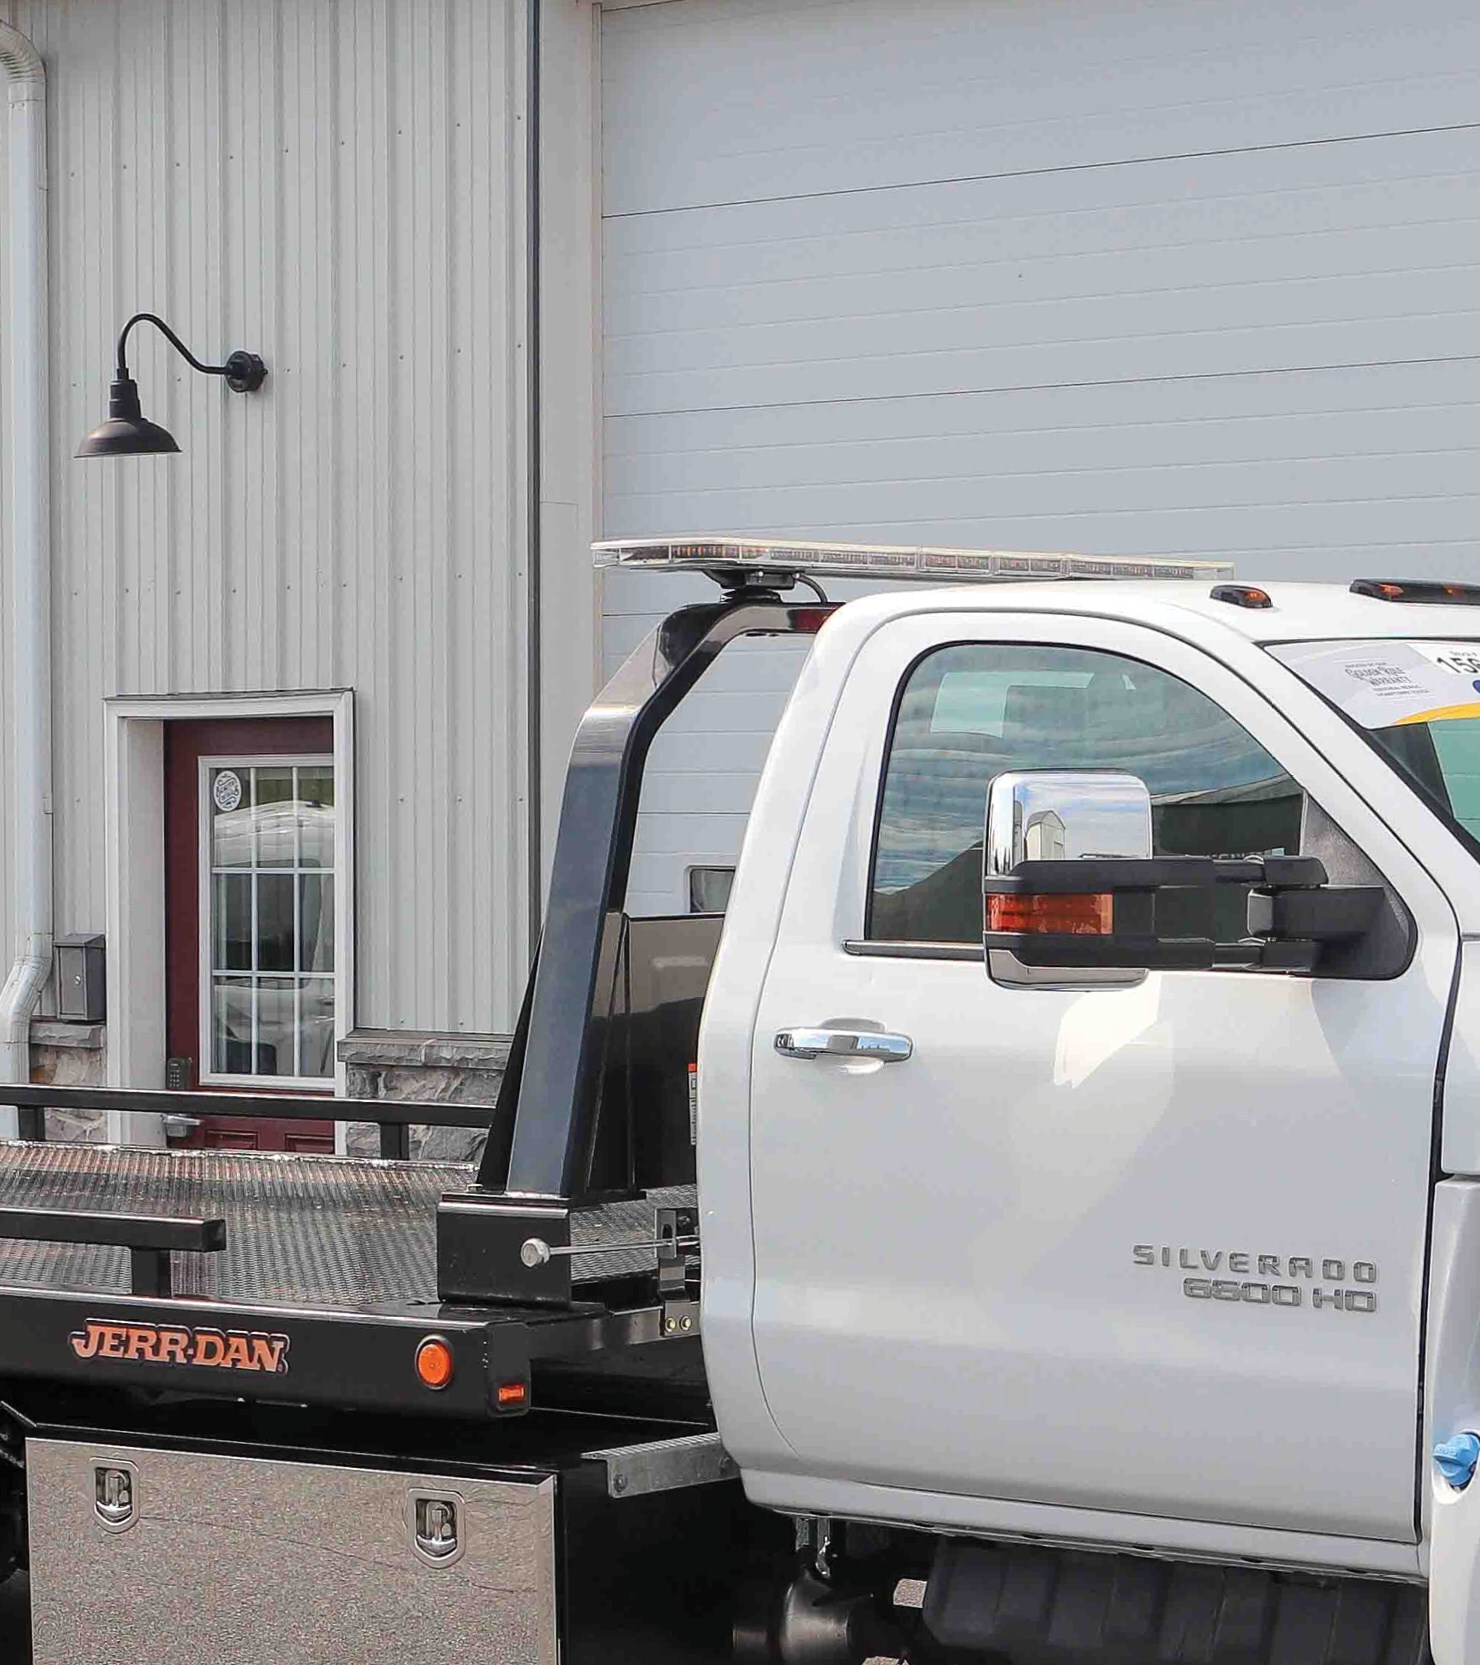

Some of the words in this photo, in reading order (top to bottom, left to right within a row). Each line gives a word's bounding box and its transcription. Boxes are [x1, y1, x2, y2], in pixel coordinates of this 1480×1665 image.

[1132, 1243, 1378, 1284] SILVERADO
[1182, 1276, 1303, 1307] 6500
[1312, 1287, 1378, 1313] HD
[70, 1321, 287, 1373] JERR-DAN
